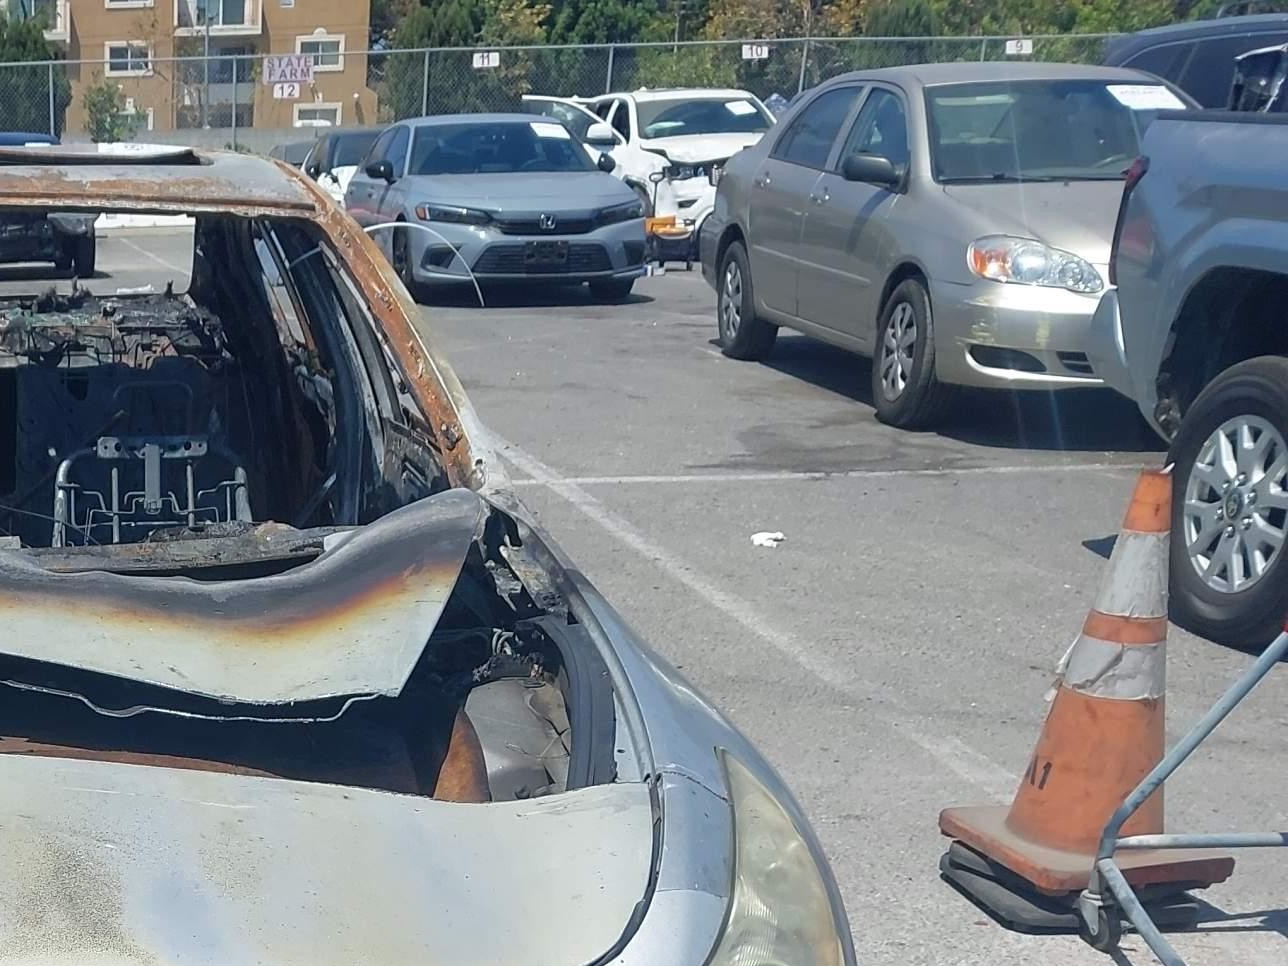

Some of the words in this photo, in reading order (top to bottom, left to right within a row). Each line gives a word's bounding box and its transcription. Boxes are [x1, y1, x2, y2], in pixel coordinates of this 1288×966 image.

[748, 44, 763, 57] 10
[1015, 40, 1023, 51] 9
[266, 55, 312, 69] STATE
[479, 52, 490, 66] 11
[268, 68, 311, 80] FARM
[278, 84, 295, 97] 12
